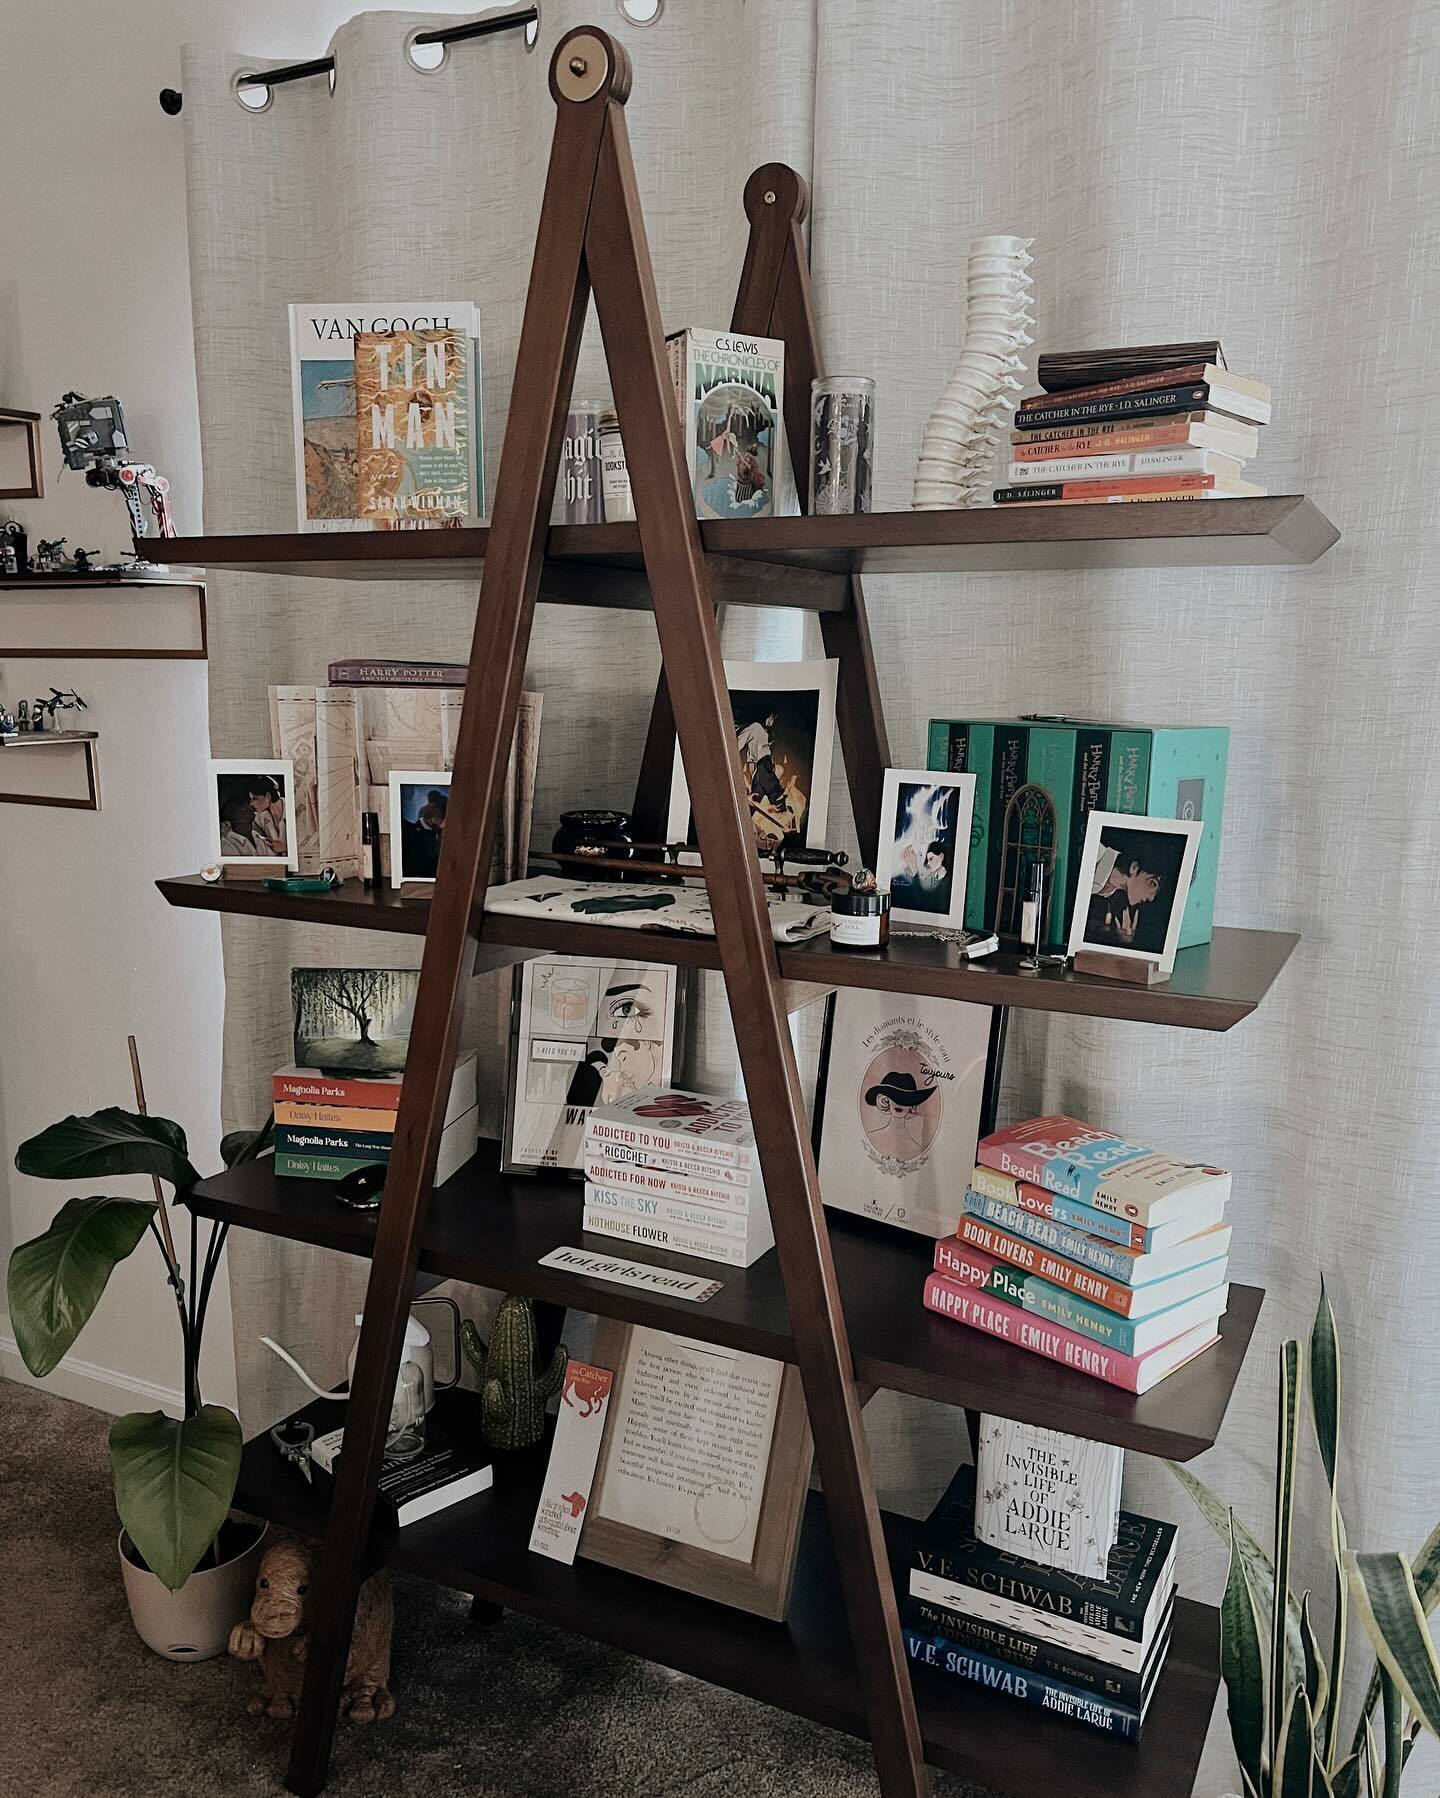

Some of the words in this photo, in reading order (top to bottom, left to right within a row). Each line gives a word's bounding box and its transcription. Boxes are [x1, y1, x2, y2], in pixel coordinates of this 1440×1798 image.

[311, 319, 364, 339] VAN
[694, 349, 710, 362] THE
[711, 351, 766, 369] CHRONICLES
[767, 360, 780, 371] OF
[732, 340, 758, 355] LEWIS
[376, 342, 446, 390] TIN
[1018, 414, 1034, 423] THE
[1035, 408, 1069, 421] CATCHER
[1071, 407, 1081, 416] IN
[1081, 405, 1098, 415] THE
[1098, 402, 1114, 413] RYE
[1134, 394, 1177, 408] SALINGER
[372, 402, 456, 449] MAN
[1031, 433, 1042, 442] THE
[1044, 429, 1074, 441] CATCHER
[1076, 428, 1084, 436] IN
[1087, 426, 1099, 435] THE
[1027, 444, 1060, 456] CATCHER
[1076, 440, 1091, 450] RYE
[605, 460, 625, 471] BOOKST
[1048, 462, 1083, 473] CATCHER
[566, 467, 592, 504] hit
[1018, 488, 1057, 498] SALINGER
[359, 668, 400, 677] HARRY
[403, 669, 443, 678] POTTER
[953, 737, 967, 772] HARRY
[1005, 739, 1020, 774] HARRY
[1088, 744, 1103, 780] HARRY
[1123, 746, 1140, 784] HARRY
[283, 1083, 320, 1097] Magnolia
[321, 1087, 346, 1097] Parks
[289, 1109, 313, 1124] Daisy
[565, 1107, 590, 1127] WA
[684, 1100, 745, 1134] ADDICTED
[713, 1121, 744, 1134] TO
[287, 1134, 324, 1147] Magnolia
[324, 1137, 349, 1148] Parks
[592, 1124, 636, 1143] ADDICTED
[639, 1132, 649, 1146] TO
[652, 1135, 671, 1150] YOU
[1020, 1127, 1122, 1160] Beach
[287, 1159, 311, 1173] Daisy
[605, 1145, 649, 1164] RICOCHET
[1063, 1142, 1144, 1170] Read
[590, 1165, 628, 1182] ADDICTED
[629, 1172, 646, 1186] FOR
[647, 1175, 667, 1190] NOW
[1001, 1153, 1041, 1184] Beach
[1045, 1167, 1081, 1198] Read
[593, 1188, 618, 1207] KISS
[620, 1194, 636, 1209] THE
[638, 1198, 658, 1215] SKY
[977, 1175, 1018, 1201] Book
[1018, 1190, 1068, 1221] Lovers
[1095, 1199, 1118, 1213] HENRY
[1096, 1191, 1118, 1204] EMILY
[588, 1215, 631, 1235] HOTHOUSE
[632, 1224, 669, 1243] FLOWER
[987, 1200, 1025, 1231] BEACH
[1026, 1219, 1058, 1245] READ
[1062, 1236, 1087, 1256] EMILY
[1088, 1247, 1116, 1270] HENRY
[1071, 1213, 1096, 1228] EMILY
[1099, 1222, 1126, 1239] HENRY
[553, 1251, 592, 1266] hot
[587, 1260, 642, 1279] girls
[639, 1273, 698, 1291] read
[963, 1221, 992, 1249] BOOK
[993, 1235, 1035, 1267] LOVERS
[1040, 1256, 1072, 1284] EMILY
[1073, 1272, 1109, 1299] HENRY
[939, 1247, 990, 1288] Happy
[992, 1269, 1036, 1305] Place
[1040, 1299, 1073, 1321] EMILY
[1075, 1314, 1114, 1338] HENRY
[931, 1286, 970, 1320] HAPPY
[972, 1304, 1010, 1337] PLACE
[1020, 1323, 1060, 1357] EMILY
[1065, 1342, 1110, 1378] HENRY
[578, 1366, 609, 1383] Catcher
[1005, 1454, 1078, 1486] INVISIBLE
[1028, 1446, 1057, 1466] THE
[1024, 1474, 1056, 1494] LIFE
[1030, 1490, 1049, 1505] OF
[1006, 1498, 1071, 1532] ADDIE
[1005, 1515, 1070, 1551] LARUE
[1149, 1527, 1164, 1557] BESTSELLER
[918, 1551, 960, 1579] V.E.
[966, 1566, 1073, 1615] SCHWAB
[920, 1606, 938, 1621] The
[941, 1613, 1006, 1645] INVISIBLE
[1008, 1637, 1038, 1657] LIFE
[1100, 1606, 1108, 1629] LARUE
[909, 1637, 940, 1667] V.E.
[945, 1652, 1028, 1698] SCHWAB
[1042, 1696, 1074, 1716] ADDIE
[1076, 1706, 1113, 1730] LARUE
[1045, 1686, 1058, 1698] THE
[1058, 1690, 1089, 1710] INVISIBLE
[1089, 1701, 1103, 1714] LIFE
[1103, 1706, 1113, 1718] OF
